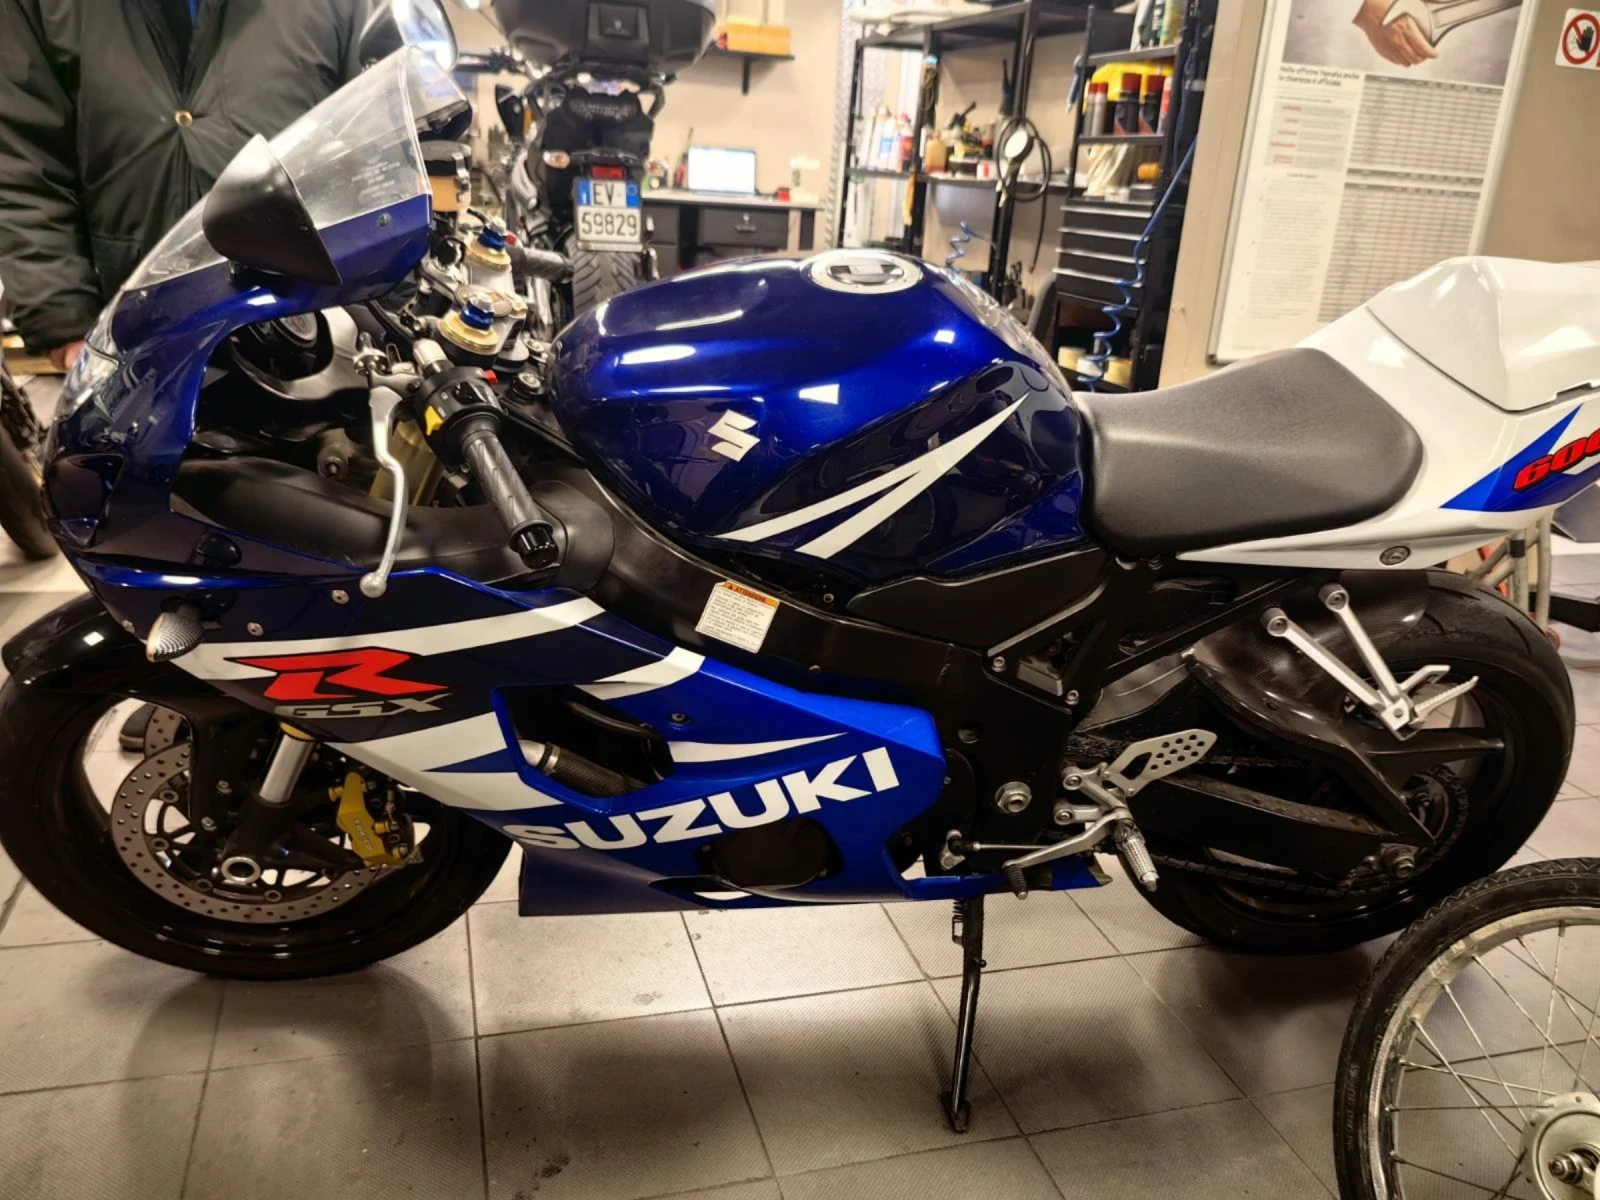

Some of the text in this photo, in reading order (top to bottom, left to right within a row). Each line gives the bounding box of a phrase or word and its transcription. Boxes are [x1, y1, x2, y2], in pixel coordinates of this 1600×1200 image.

[592, 183, 615, 206] EV
[582, 212, 637, 236] 59829
[230, 648, 449, 701] R
[273, 692, 453, 719] GSX
[502, 746, 900, 850] SUZUKI
